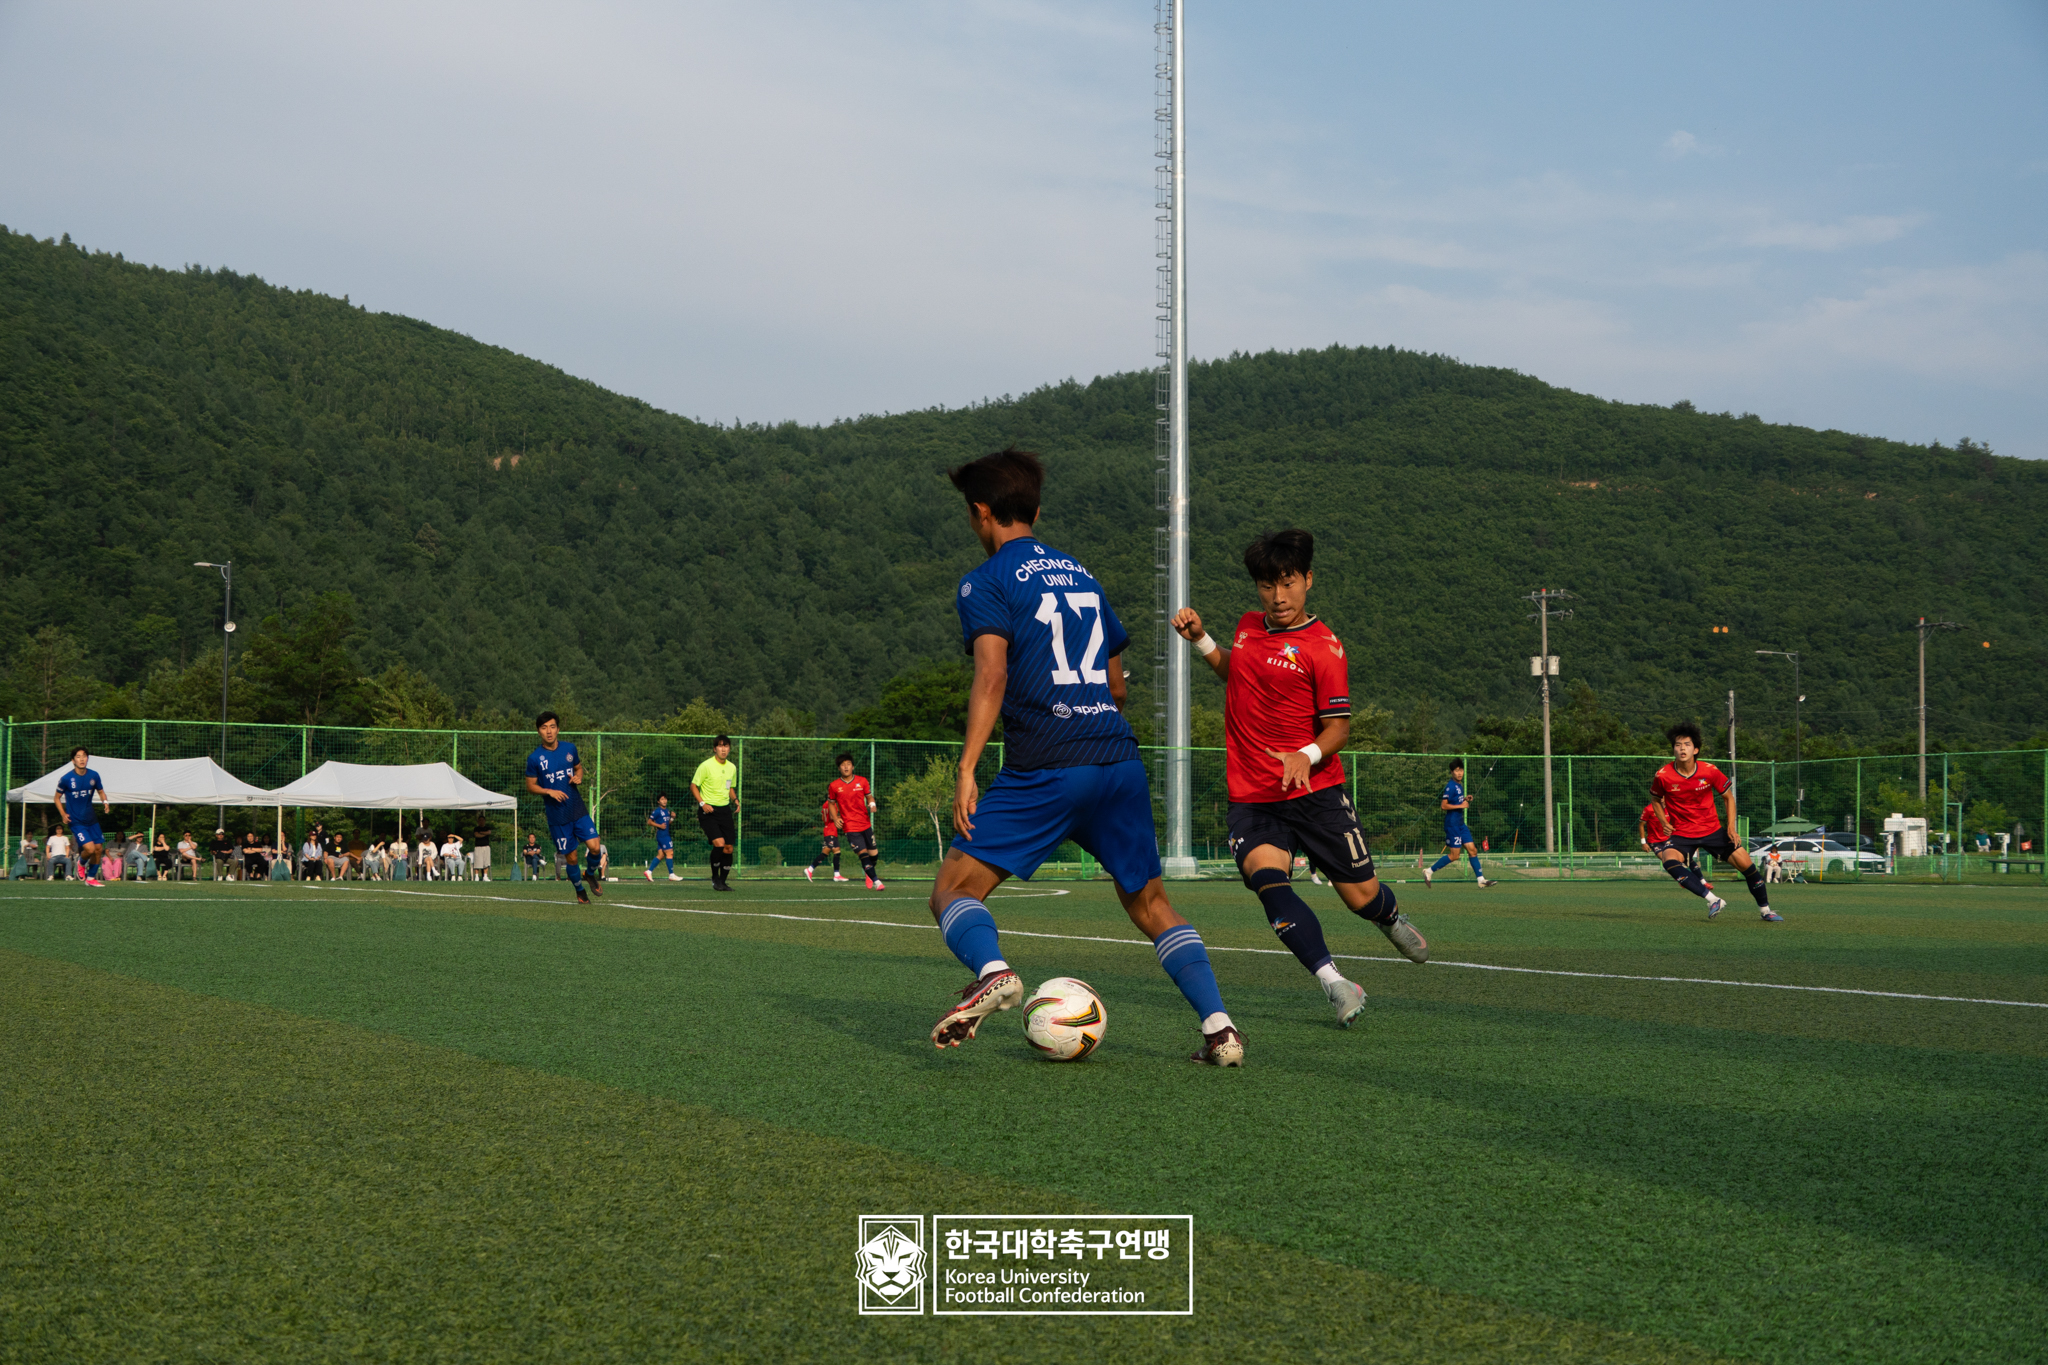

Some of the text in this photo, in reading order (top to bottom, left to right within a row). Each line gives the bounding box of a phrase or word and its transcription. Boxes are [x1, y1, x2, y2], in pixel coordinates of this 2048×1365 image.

[1041, 573, 1078, 587] UNIV.
[1034, 592, 1108, 686] 17
[540, 759, 549, 771] 17
[77, 832, 85, 842] 8
[556, 837, 568, 851] 17
[1343, 827, 1368, 860] 11
